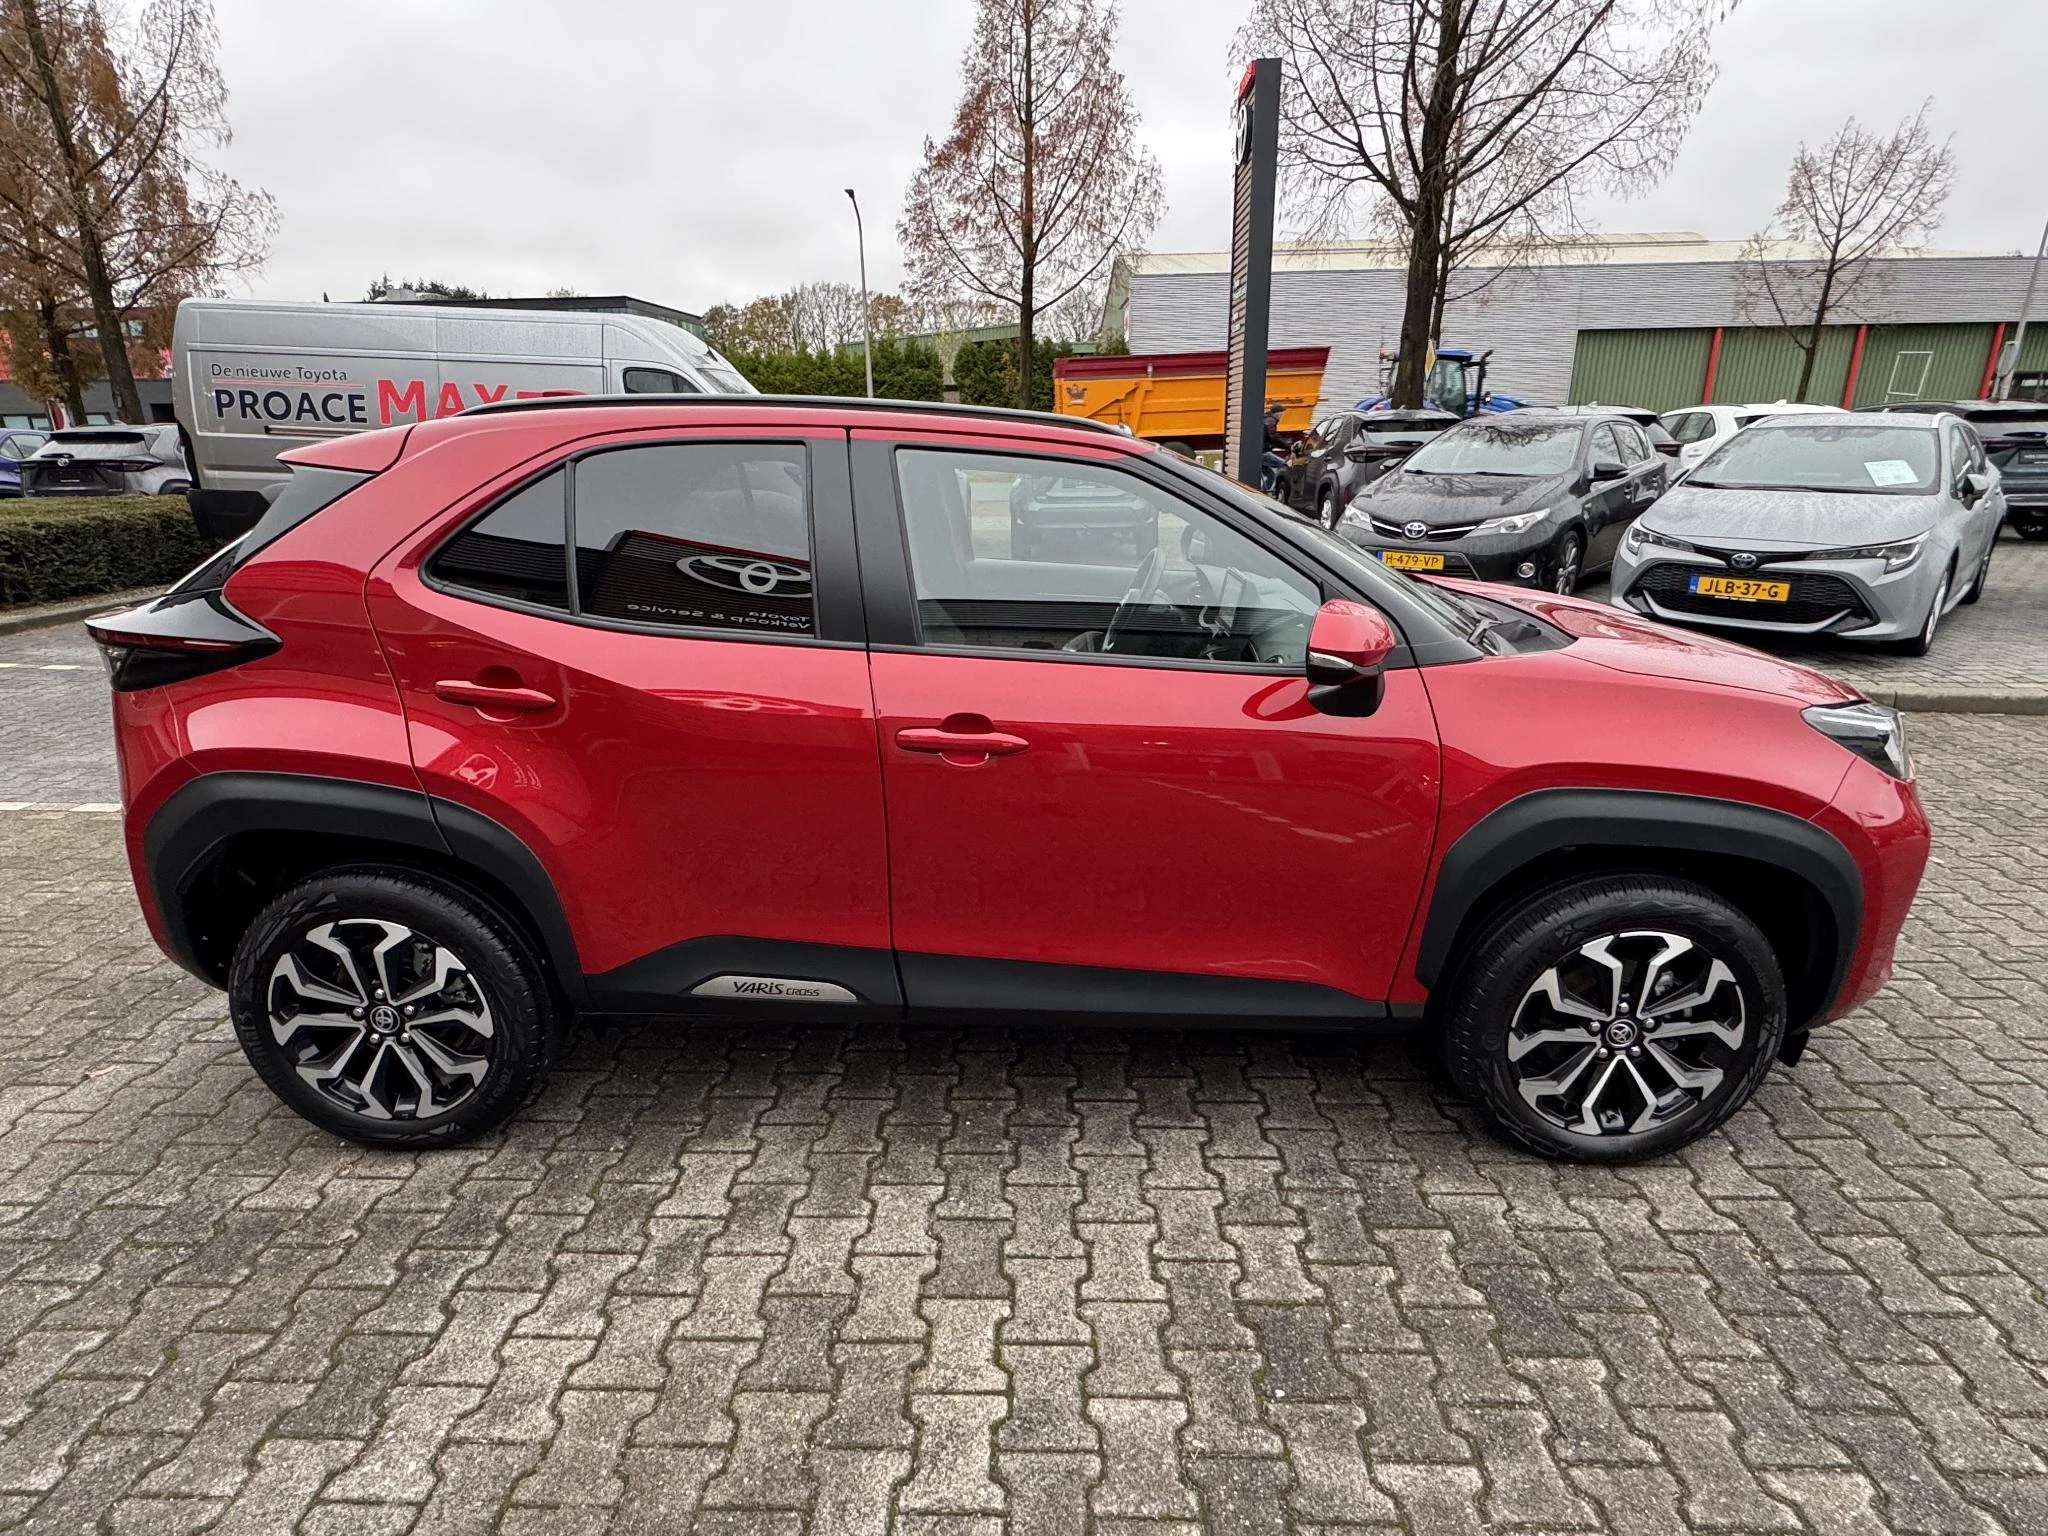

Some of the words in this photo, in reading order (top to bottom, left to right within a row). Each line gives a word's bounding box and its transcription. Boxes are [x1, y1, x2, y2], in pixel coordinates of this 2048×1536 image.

[211, 363, 232, 377] De
[236, 364, 292, 379] nieuwe
[296, 366, 348, 383] Toyota
[214, 388, 368, 424] PROACE
[1386, 553, 1439, 568] H-479-VP
[1704, 579, 1780, 598] JLB-37-G
[785, 987, 820, 997] CROSS
